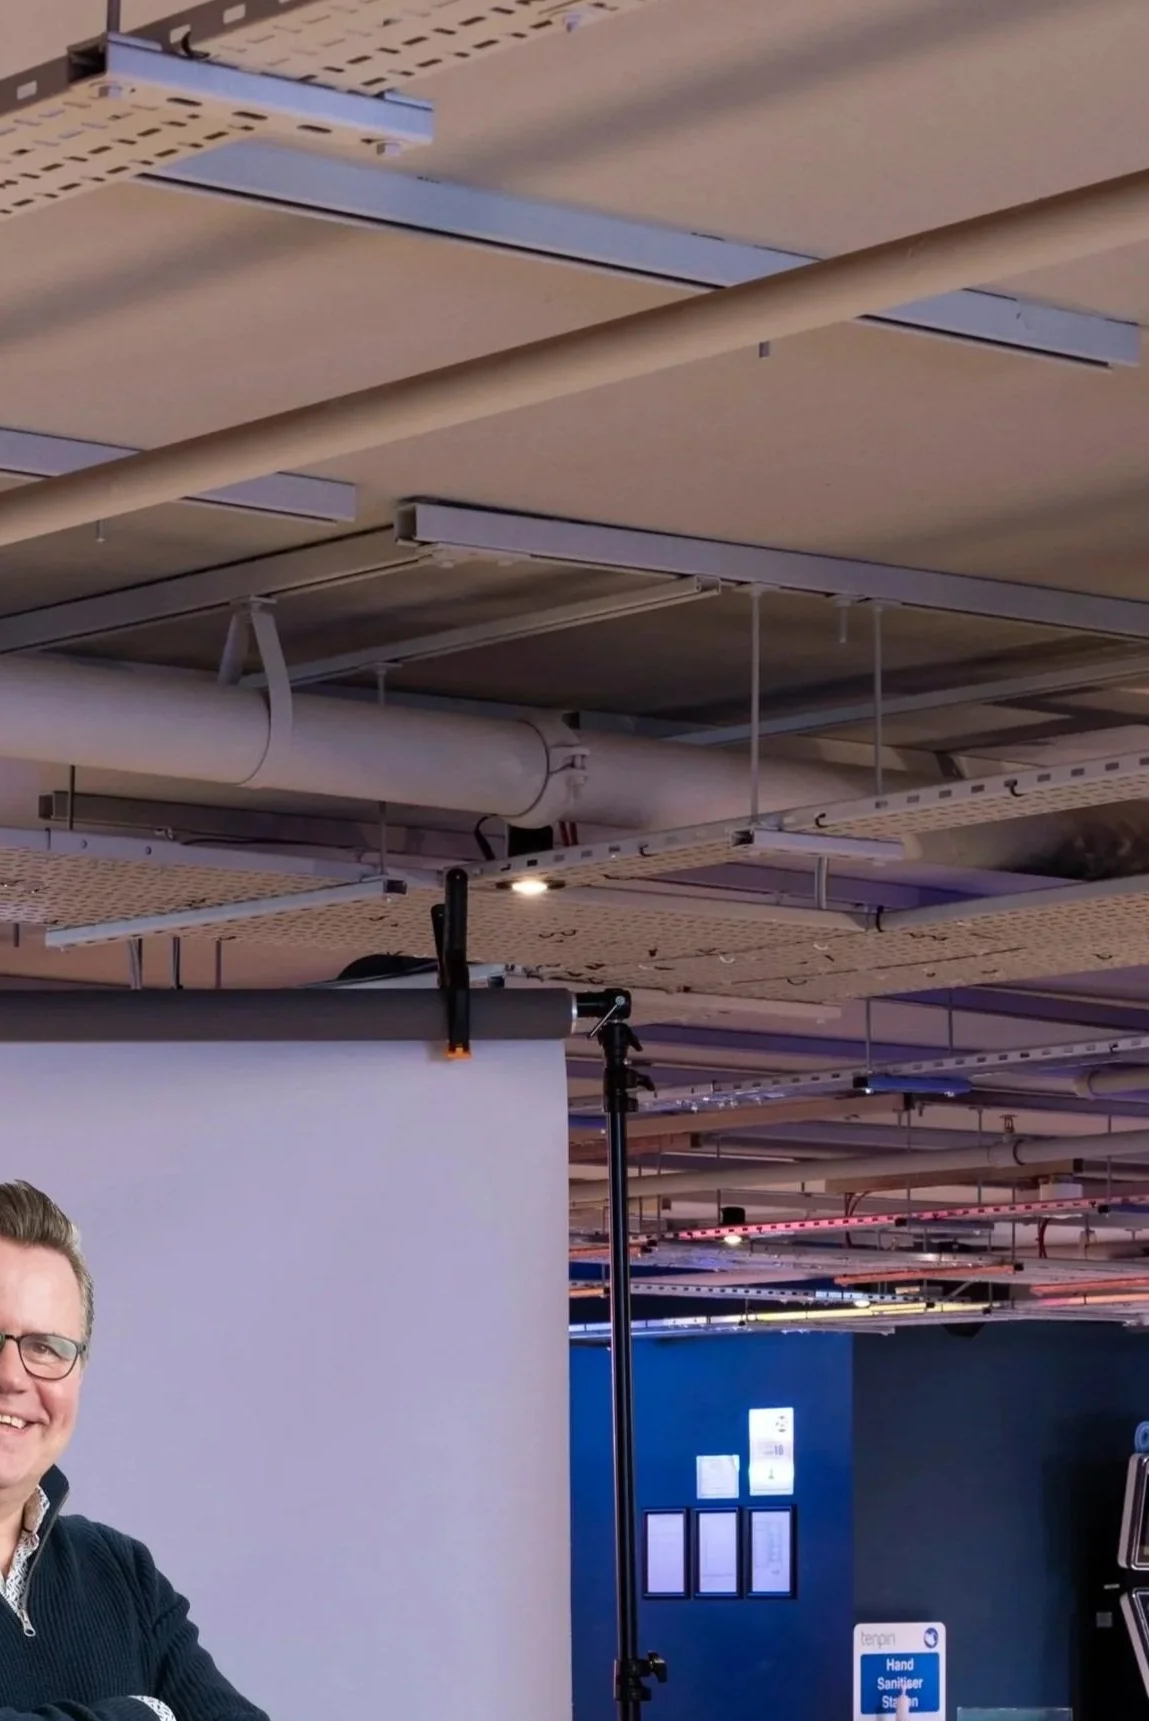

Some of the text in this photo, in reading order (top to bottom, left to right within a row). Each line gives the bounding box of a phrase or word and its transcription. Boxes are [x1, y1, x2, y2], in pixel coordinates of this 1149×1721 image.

[861, 1632, 896, 1649] tenpin
[886, 1658, 914, 1671] Hand
[877, 1676, 923, 1690] Sanitiser
[882, 1695, 919, 1709] Staon
